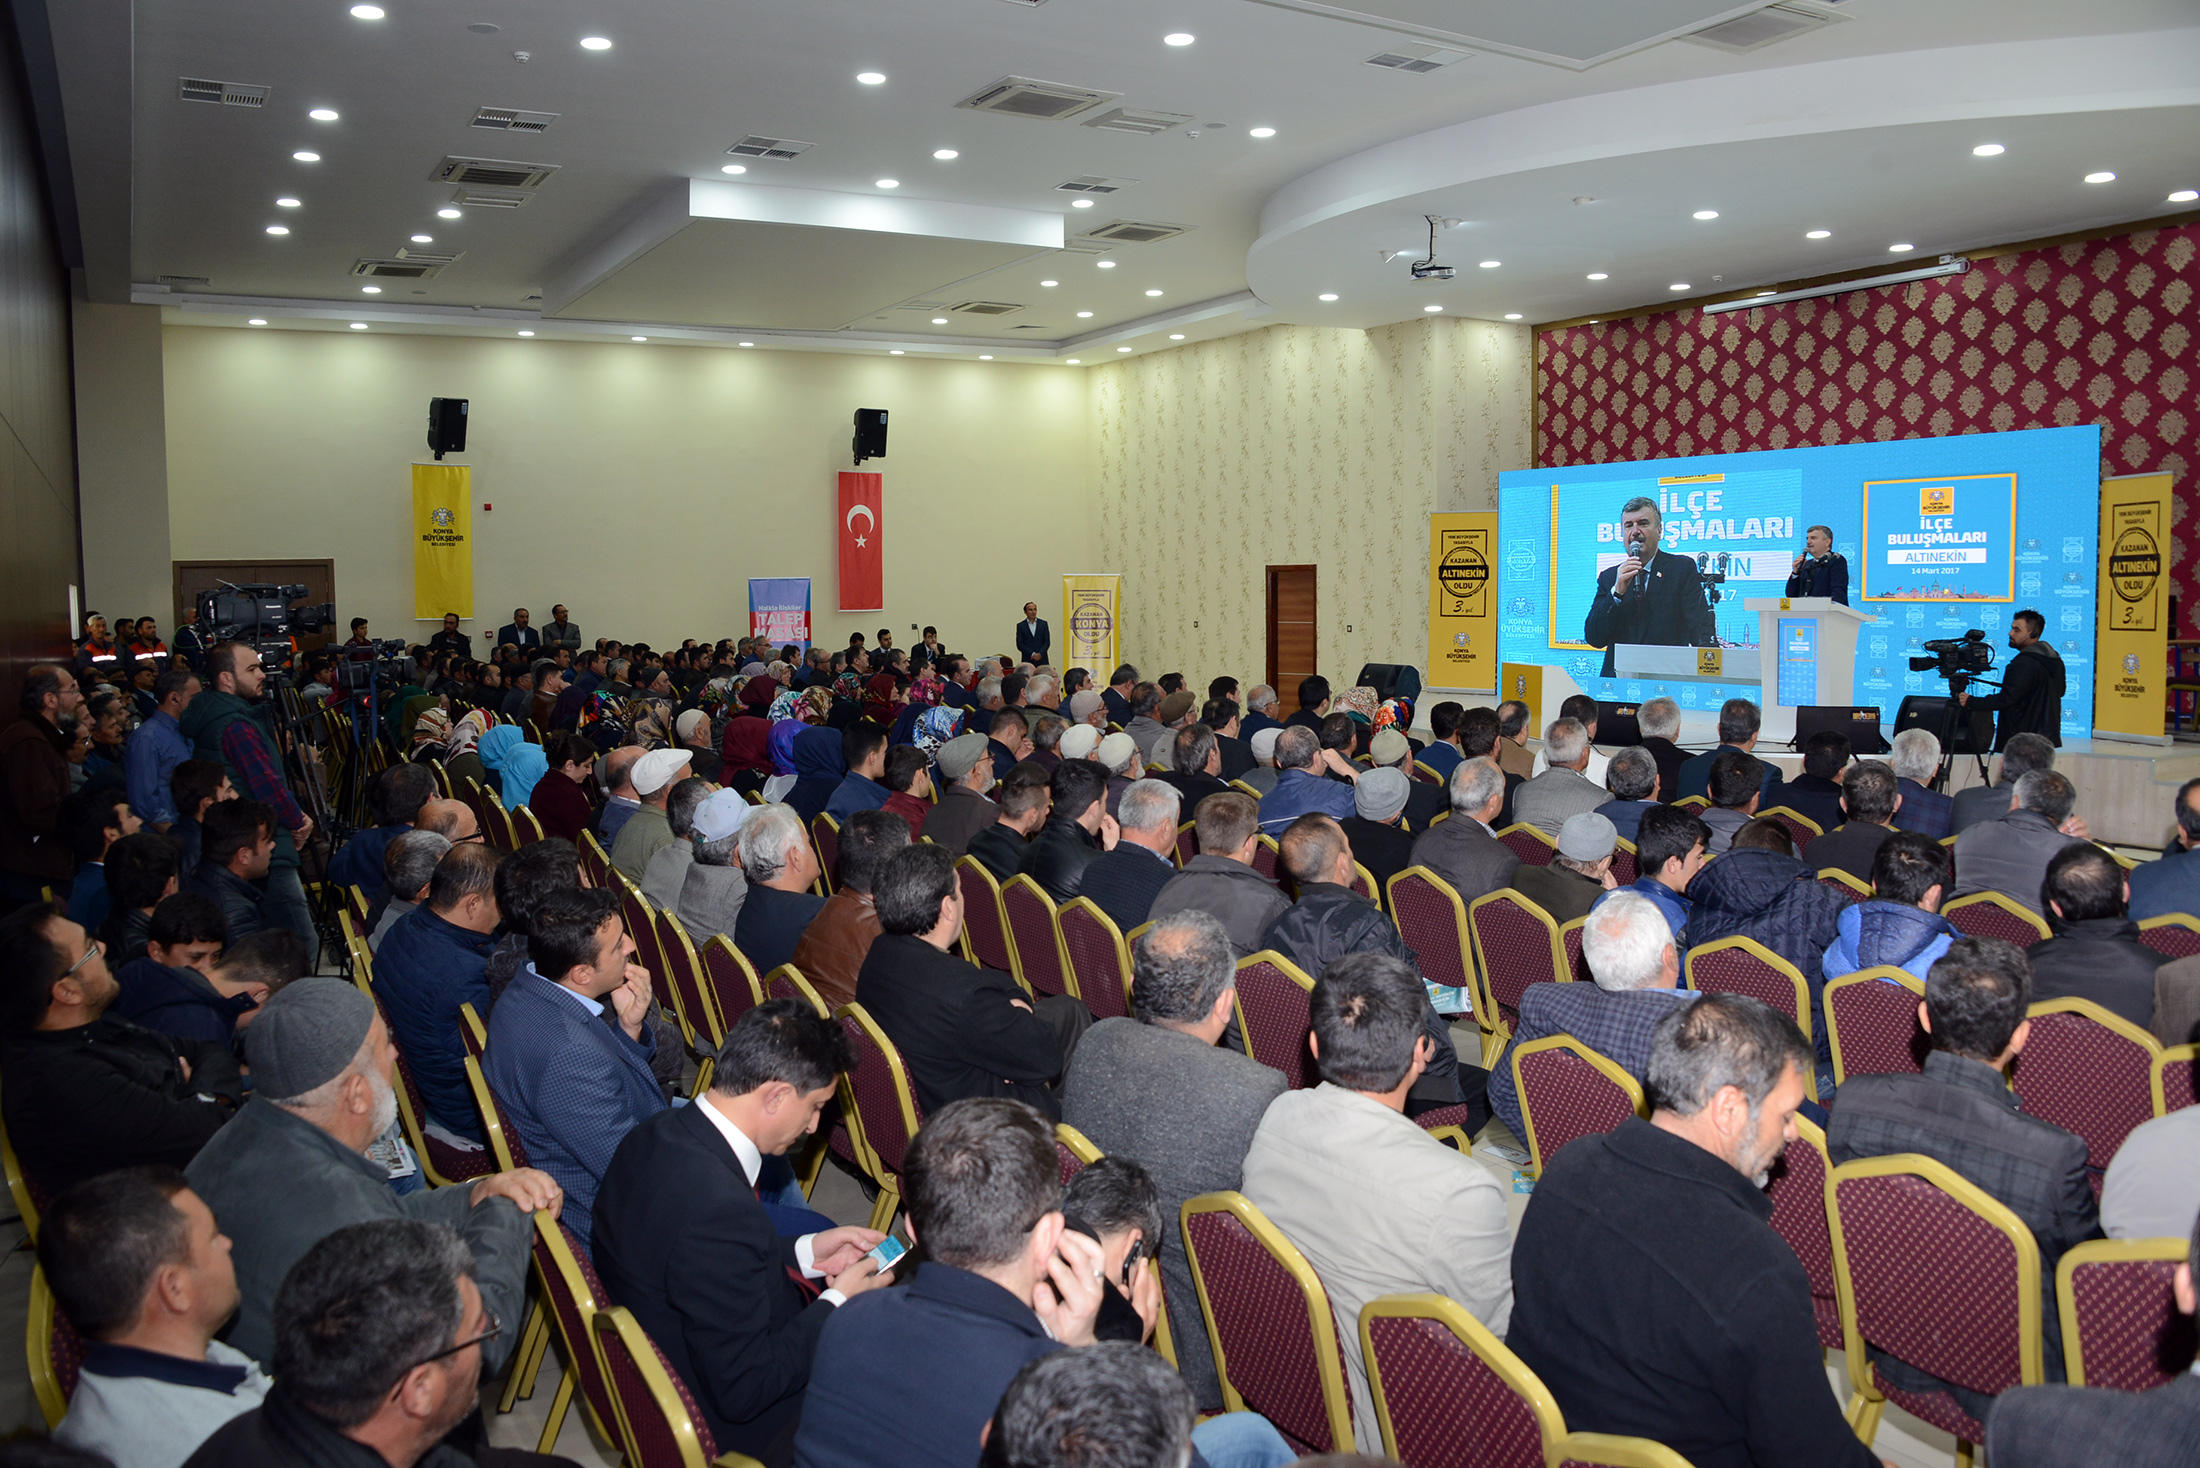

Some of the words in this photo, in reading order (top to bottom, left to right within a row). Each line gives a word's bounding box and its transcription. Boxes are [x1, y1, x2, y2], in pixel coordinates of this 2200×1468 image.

[1660, 488, 1723, 519] İLÇE
[1920, 517, 1953, 533] İLÇE
[422, 534, 464, 542] BÜYÜKŞEHİR
[1887, 532, 1987, 548] BULUŞMALARI
[2121, 544, 2149, 552] KAZANAN
[1905, 550, 1967, 562] ALTINEKİN
[2112, 558, 2158, 574] ALTINEKİN
[1442, 567, 1486, 578] ALTINEKİN
[2124, 581, 2143, 590] OLDU
[758, 613, 803, 626] TALEP
[1075, 620, 1109, 629] KONYA
[754, 627, 809, 639] MASASI
[1500, 624, 1545, 634] ÜYÜKŞEHİR
